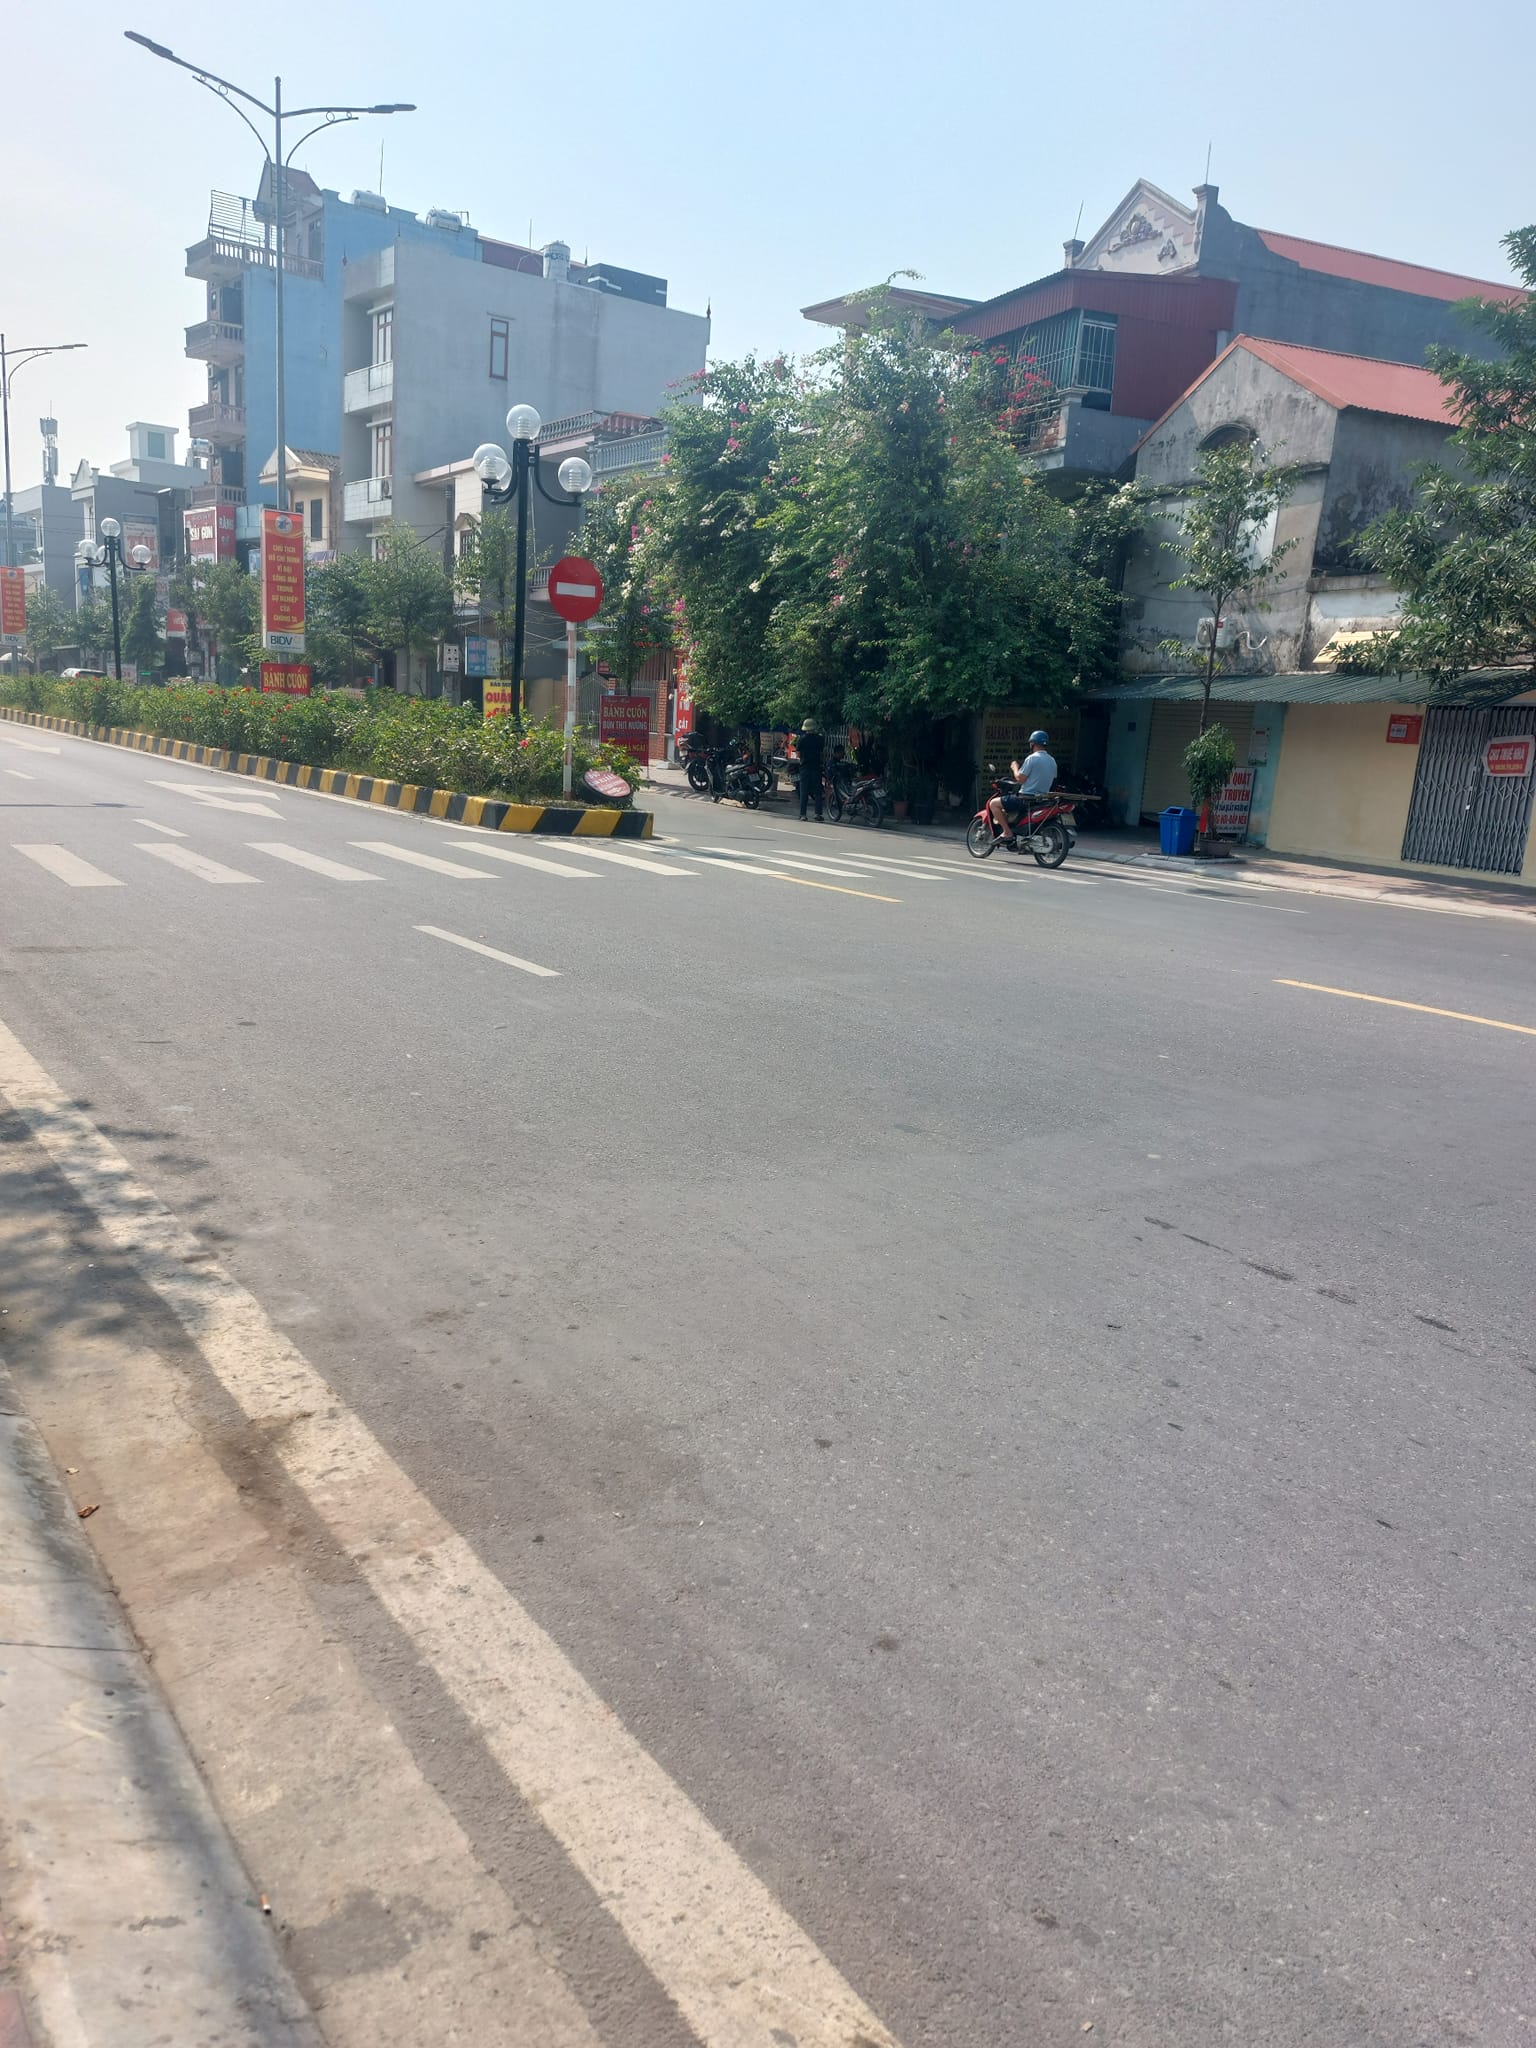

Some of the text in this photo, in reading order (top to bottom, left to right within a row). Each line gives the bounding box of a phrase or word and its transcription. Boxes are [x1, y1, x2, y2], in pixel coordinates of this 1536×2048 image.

[270, 635, 293, 646] BIDV
[263, 666, 308, 689] BÁNH CUỐN
[603, 703, 647, 718] BÁNH CUỐN
